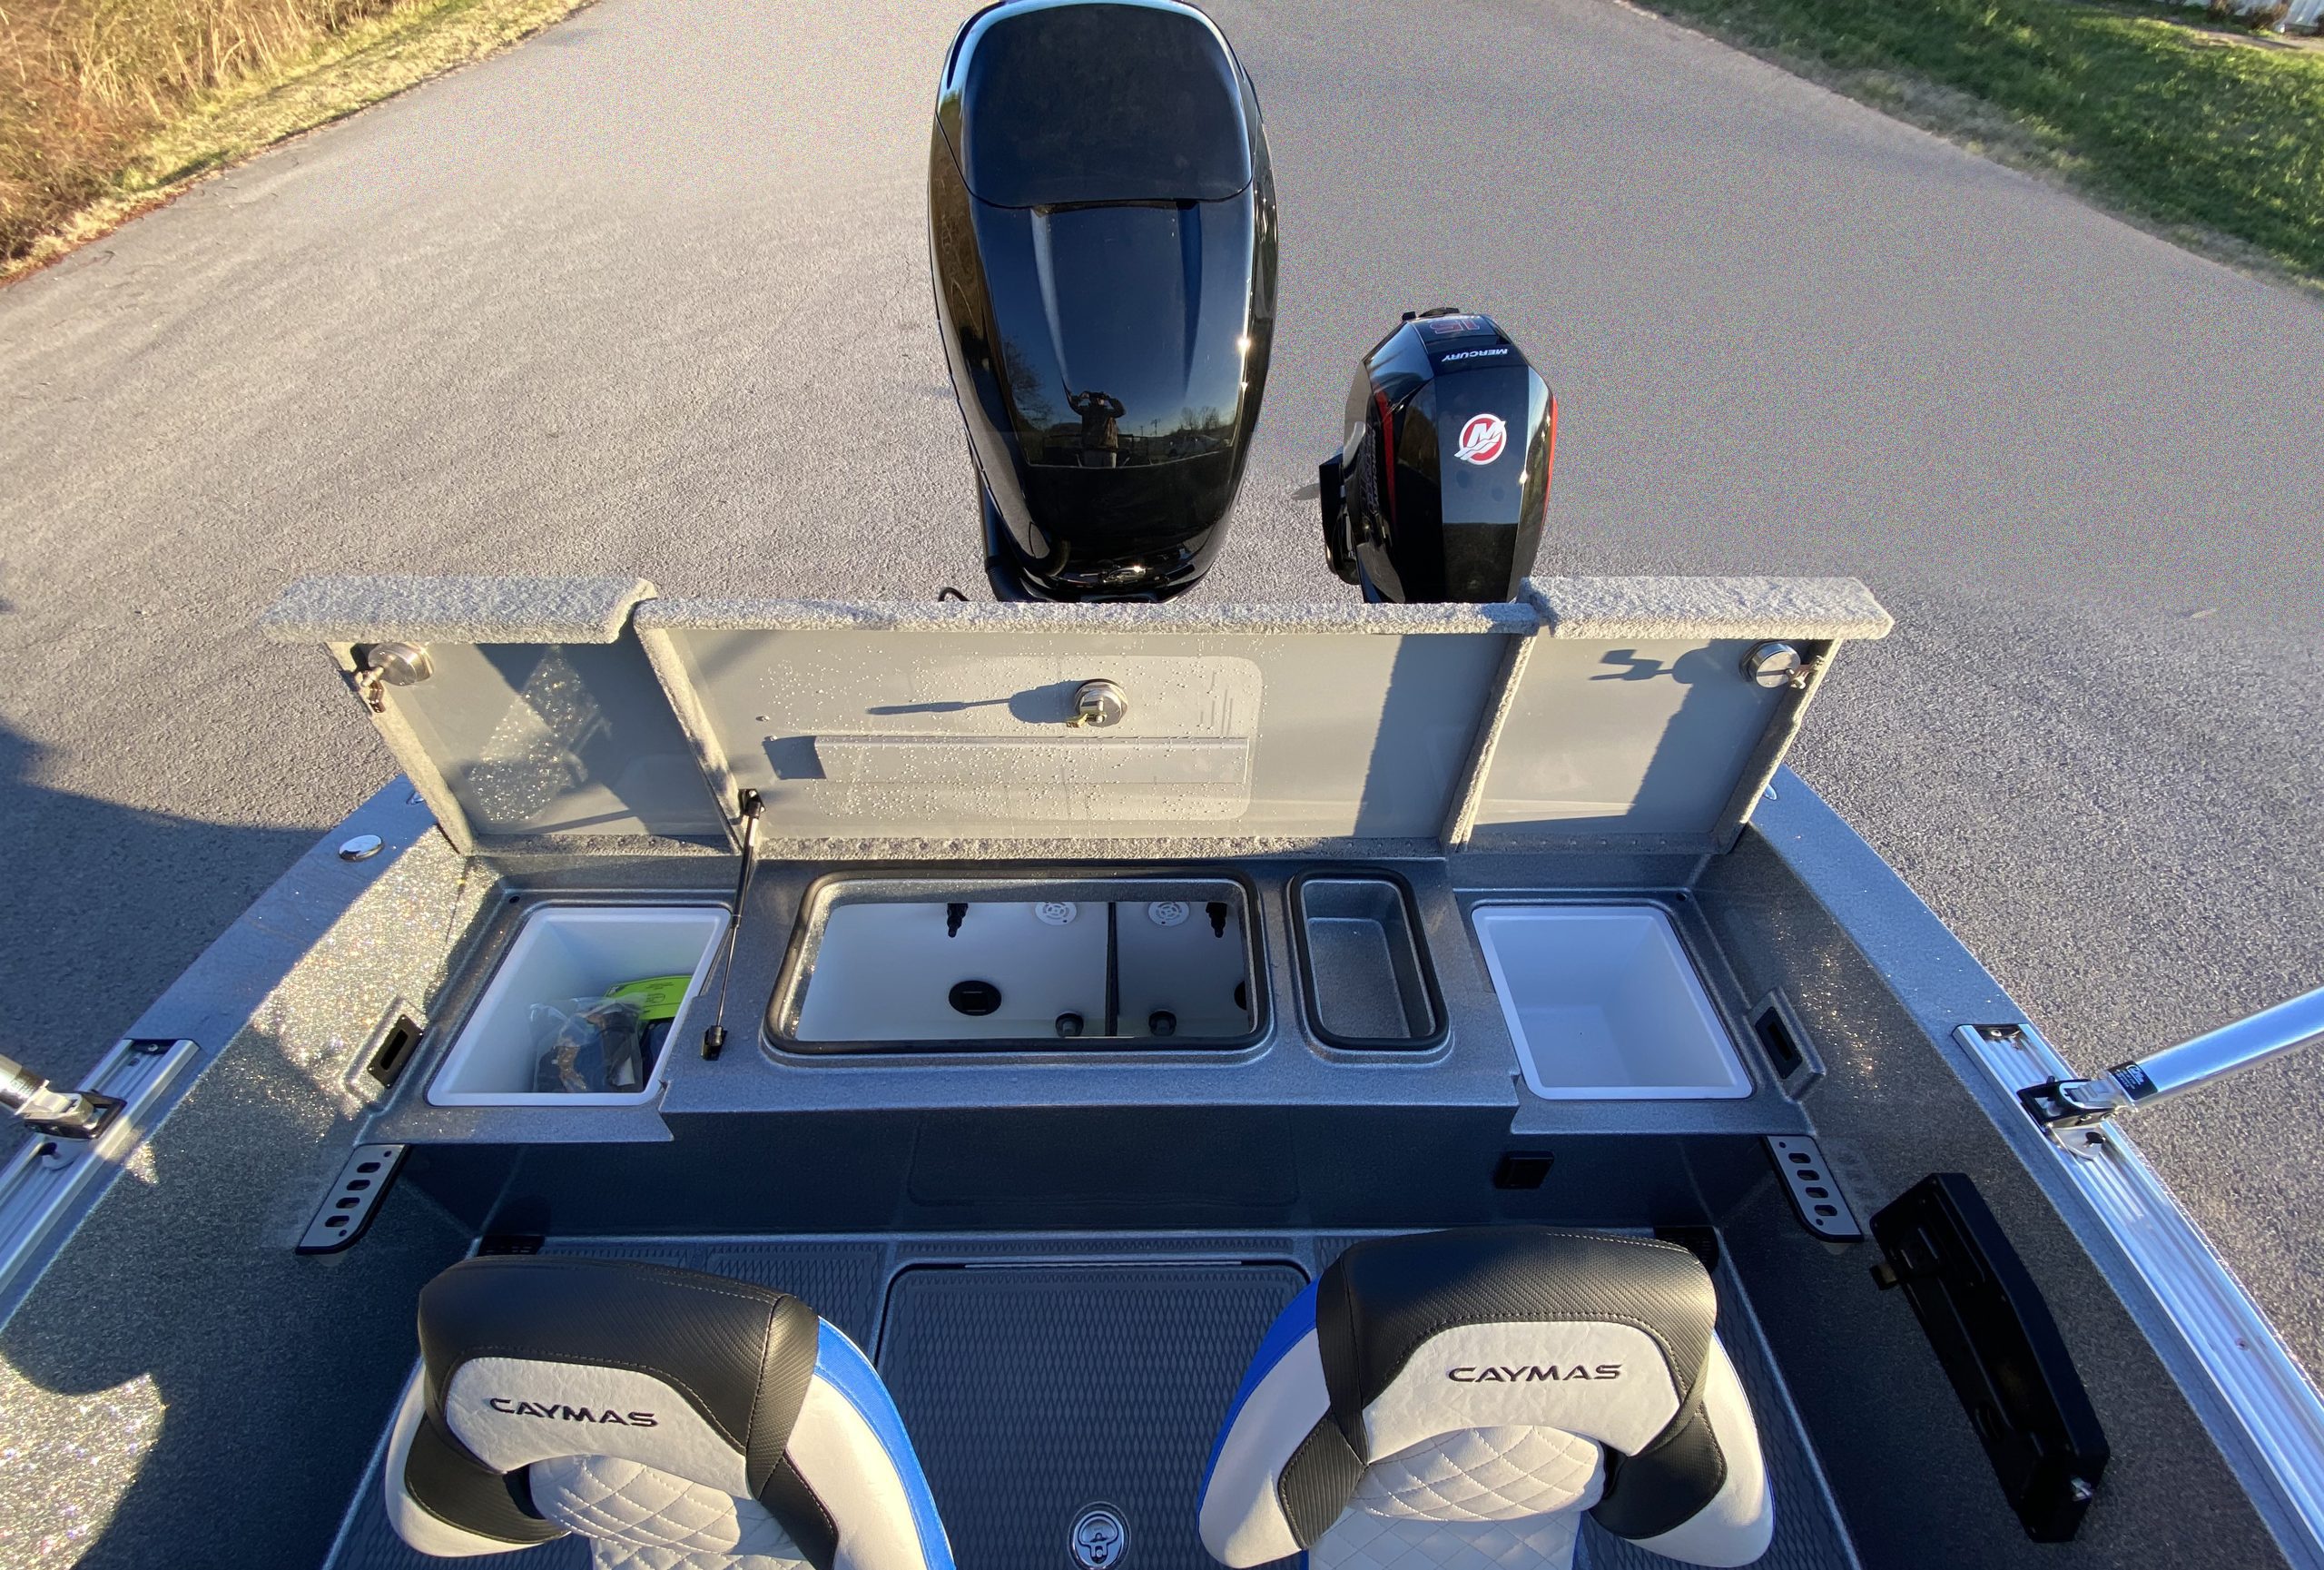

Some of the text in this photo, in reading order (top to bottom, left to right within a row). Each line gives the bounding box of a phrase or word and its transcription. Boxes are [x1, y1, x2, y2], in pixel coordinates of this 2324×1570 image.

[1442, 348, 1508, 362] MERCURY
[1448, 1364, 1623, 1383] CAYMAS
[489, 1397, 659, 1427] CAYMAS
